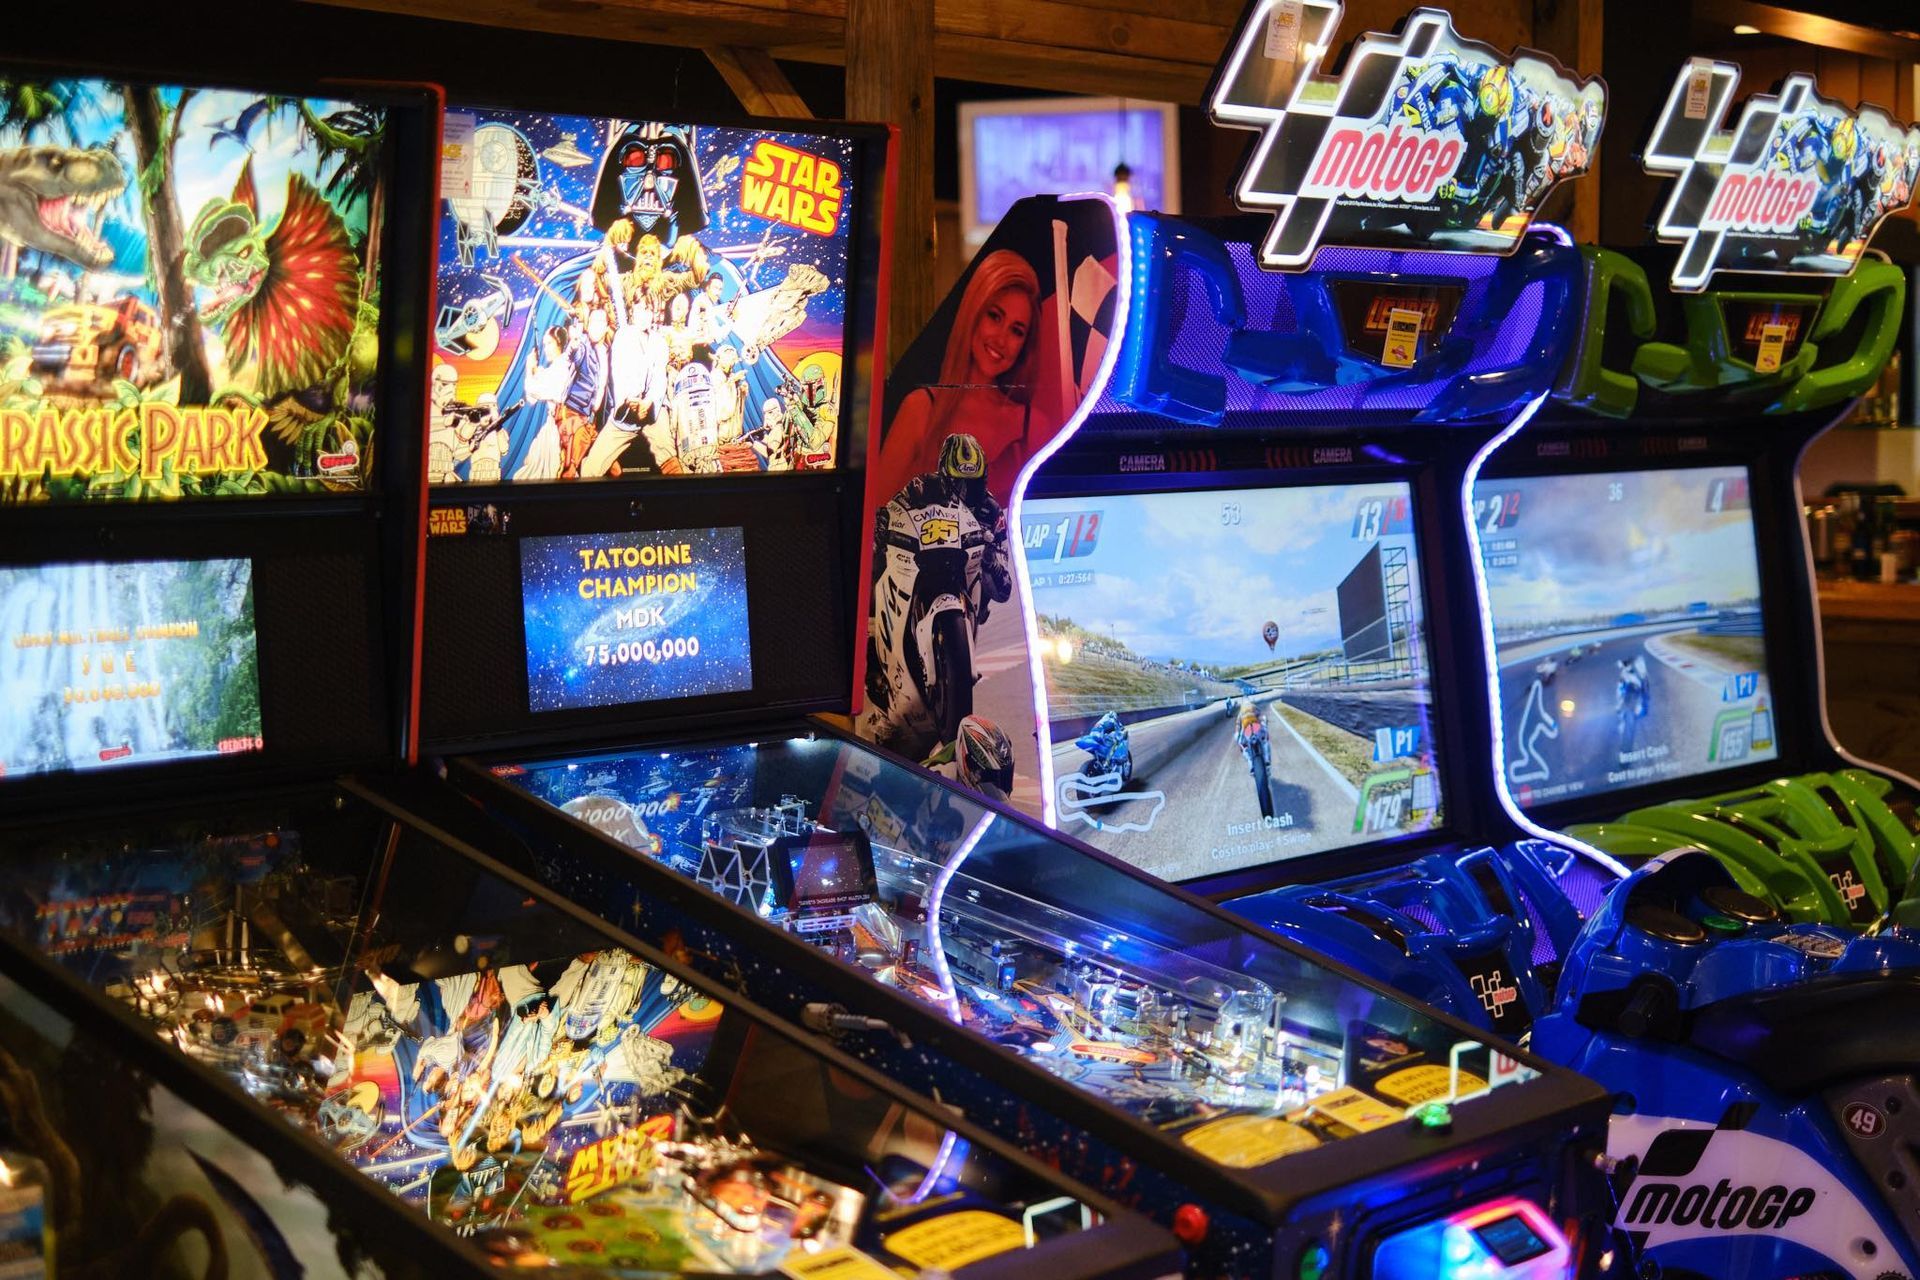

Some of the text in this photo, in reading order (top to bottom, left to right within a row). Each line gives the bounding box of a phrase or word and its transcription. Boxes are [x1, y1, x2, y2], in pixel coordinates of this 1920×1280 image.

[745, 142, 842, 200] STAR
[743, 174, 839, 234] WARS
[140, 402, 269, 480] PARK
[1119, 454, 1165, 472] CAMERA
[1313, 448, 1353, 463] CAMERA
[429, 508, 466, 522] STAR
[430, 521, 467, 535] WARS
[920, 518, 960, 546] 35
[1024, 524, 1050, 549] LAP
[579, 544, 692, 570] TATOOINE
[578, 572, 697, 599] CHAMPION
[1032, 575, 1046, 587] AP
[616, 606, 666, 629] MDK
[584, 636, 700, 666] 75,000,000
[1396, 728, 1413, 755] P1
[1227, 812, 1294, 836] Insert Cash
[1373, 793, 1401, 831] 179
[1211, 846, 1237, 860] Cost
[1851, 1109, 1876, 1132] 49
